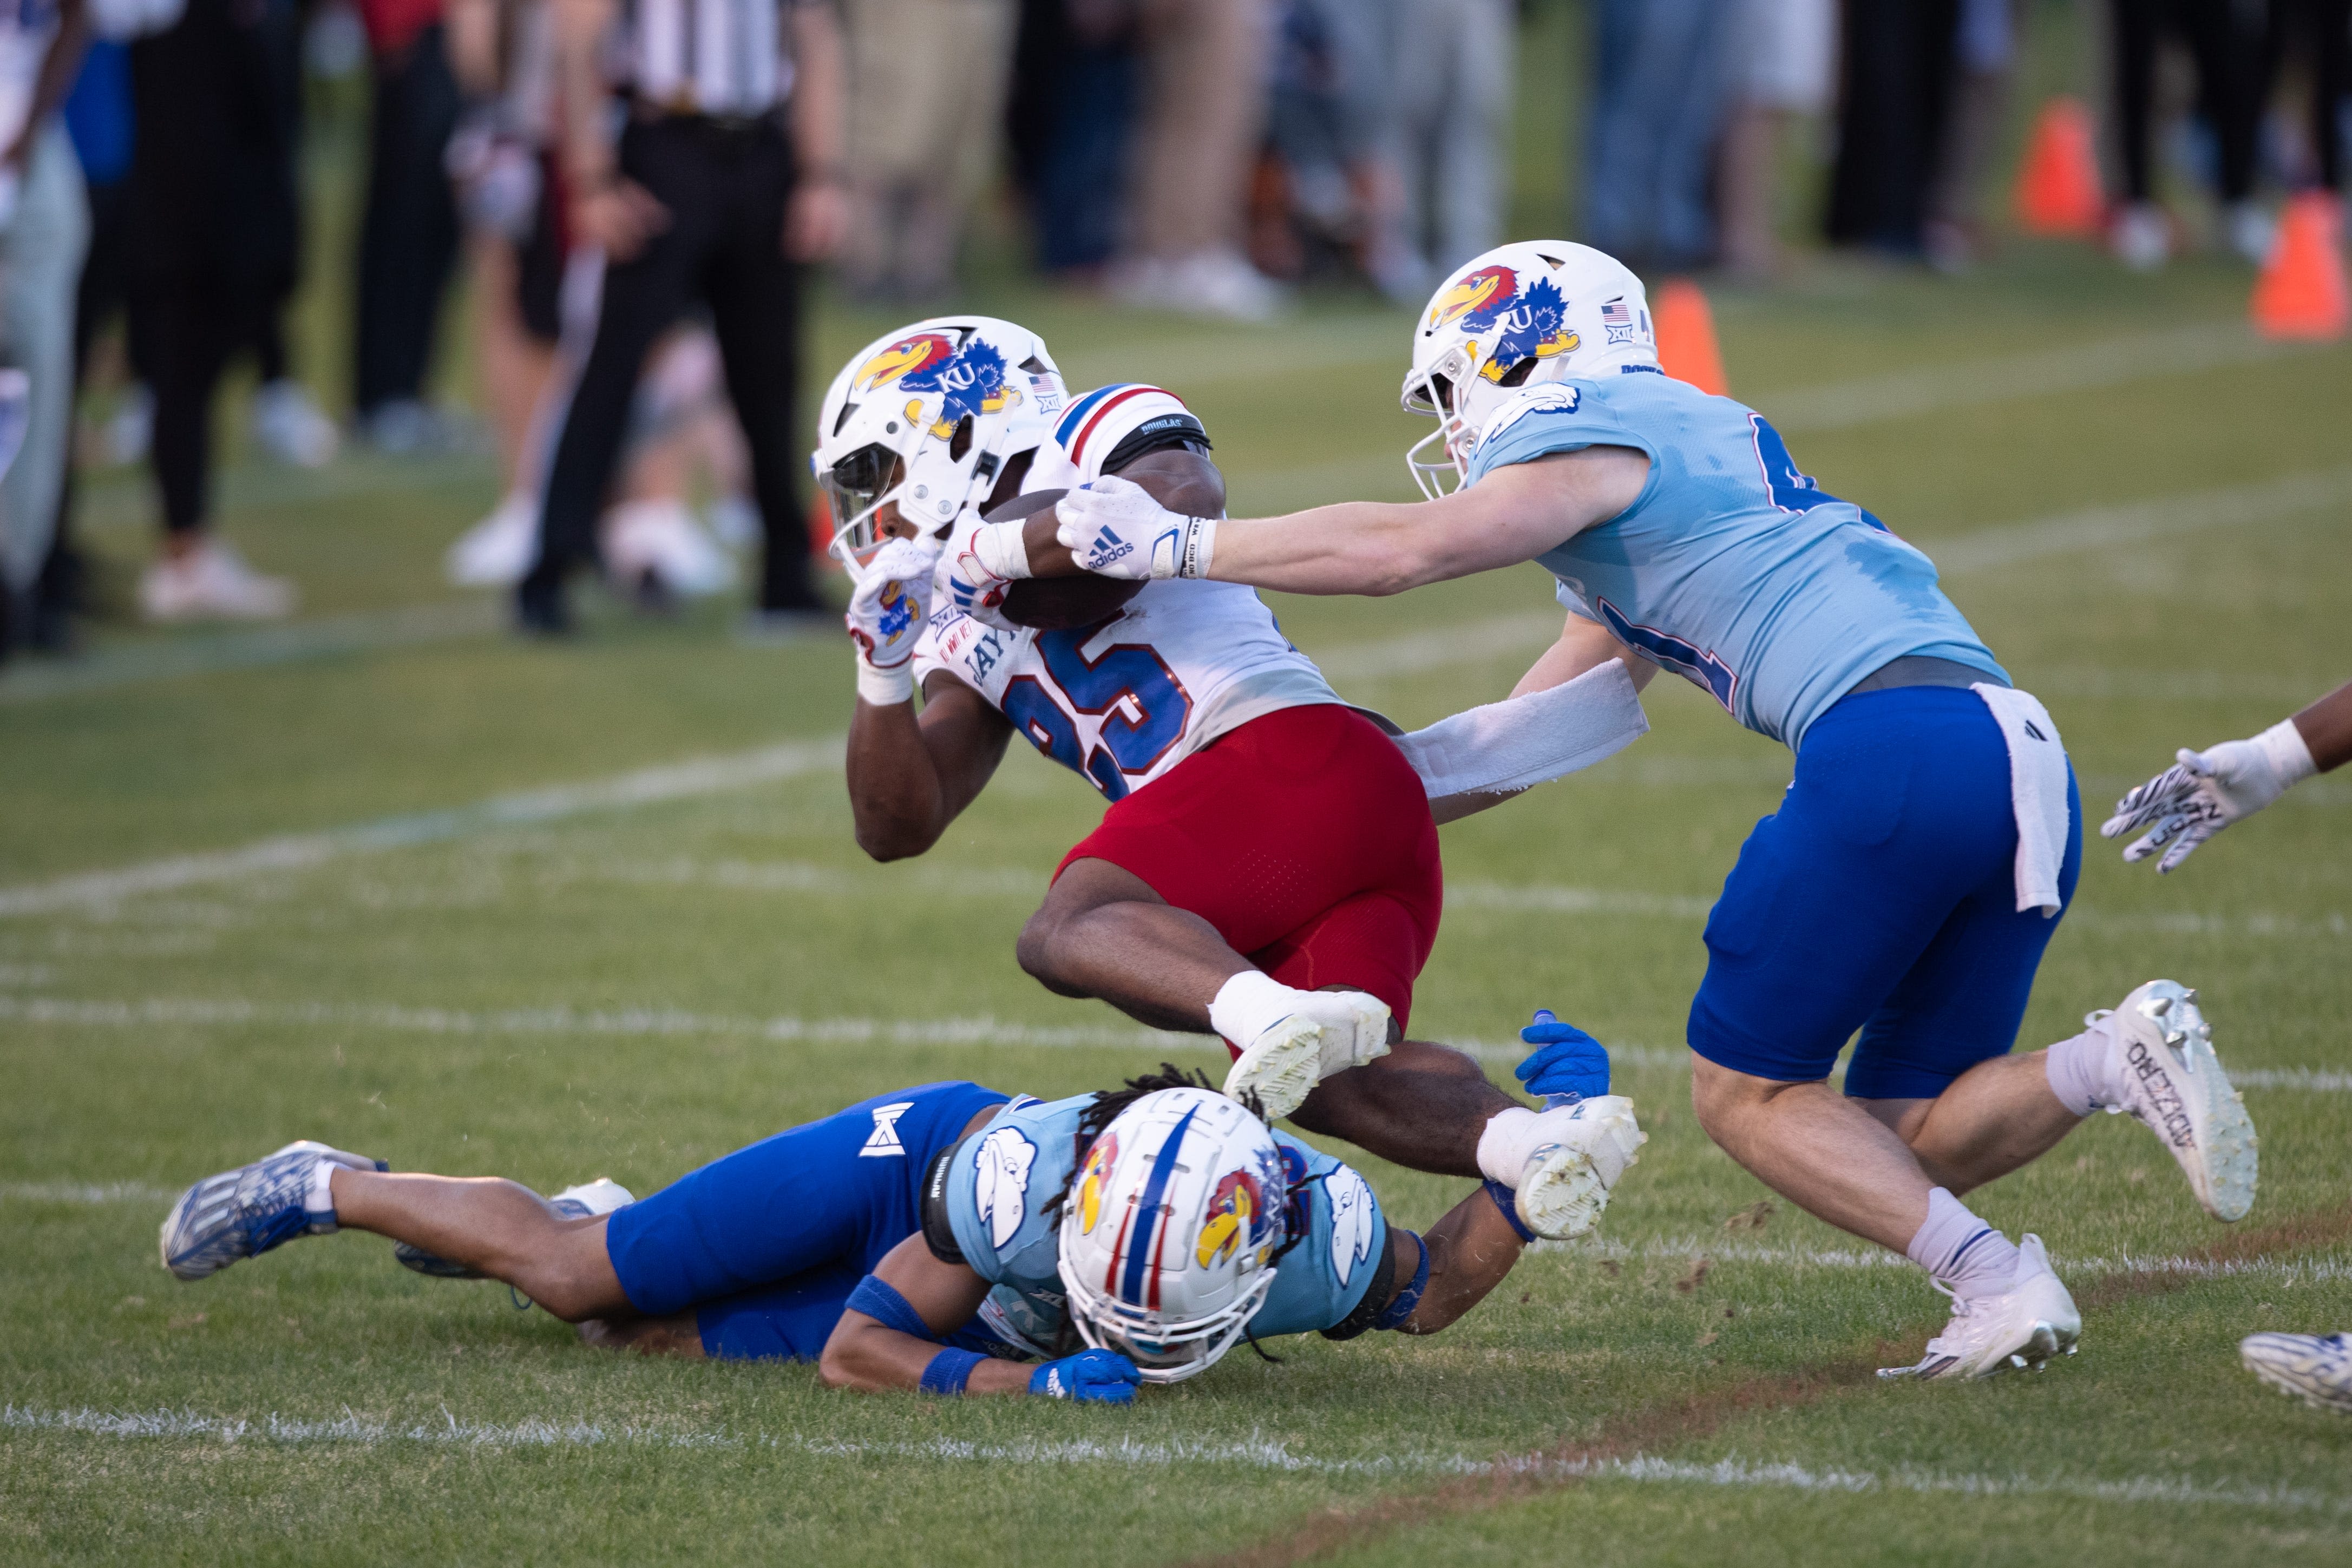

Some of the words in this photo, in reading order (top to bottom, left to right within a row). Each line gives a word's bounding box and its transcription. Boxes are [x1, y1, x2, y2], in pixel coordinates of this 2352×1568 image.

[935, 362, 976, 394] KU
[1141, 418, 1182, 435] DOUGLAS
[1089, 542, 1135, 570] adidas
[959, 619, 973, 641] VET
[965, 628, 1017, 687] JAY
[1001, 608, 1194, 804] 25
